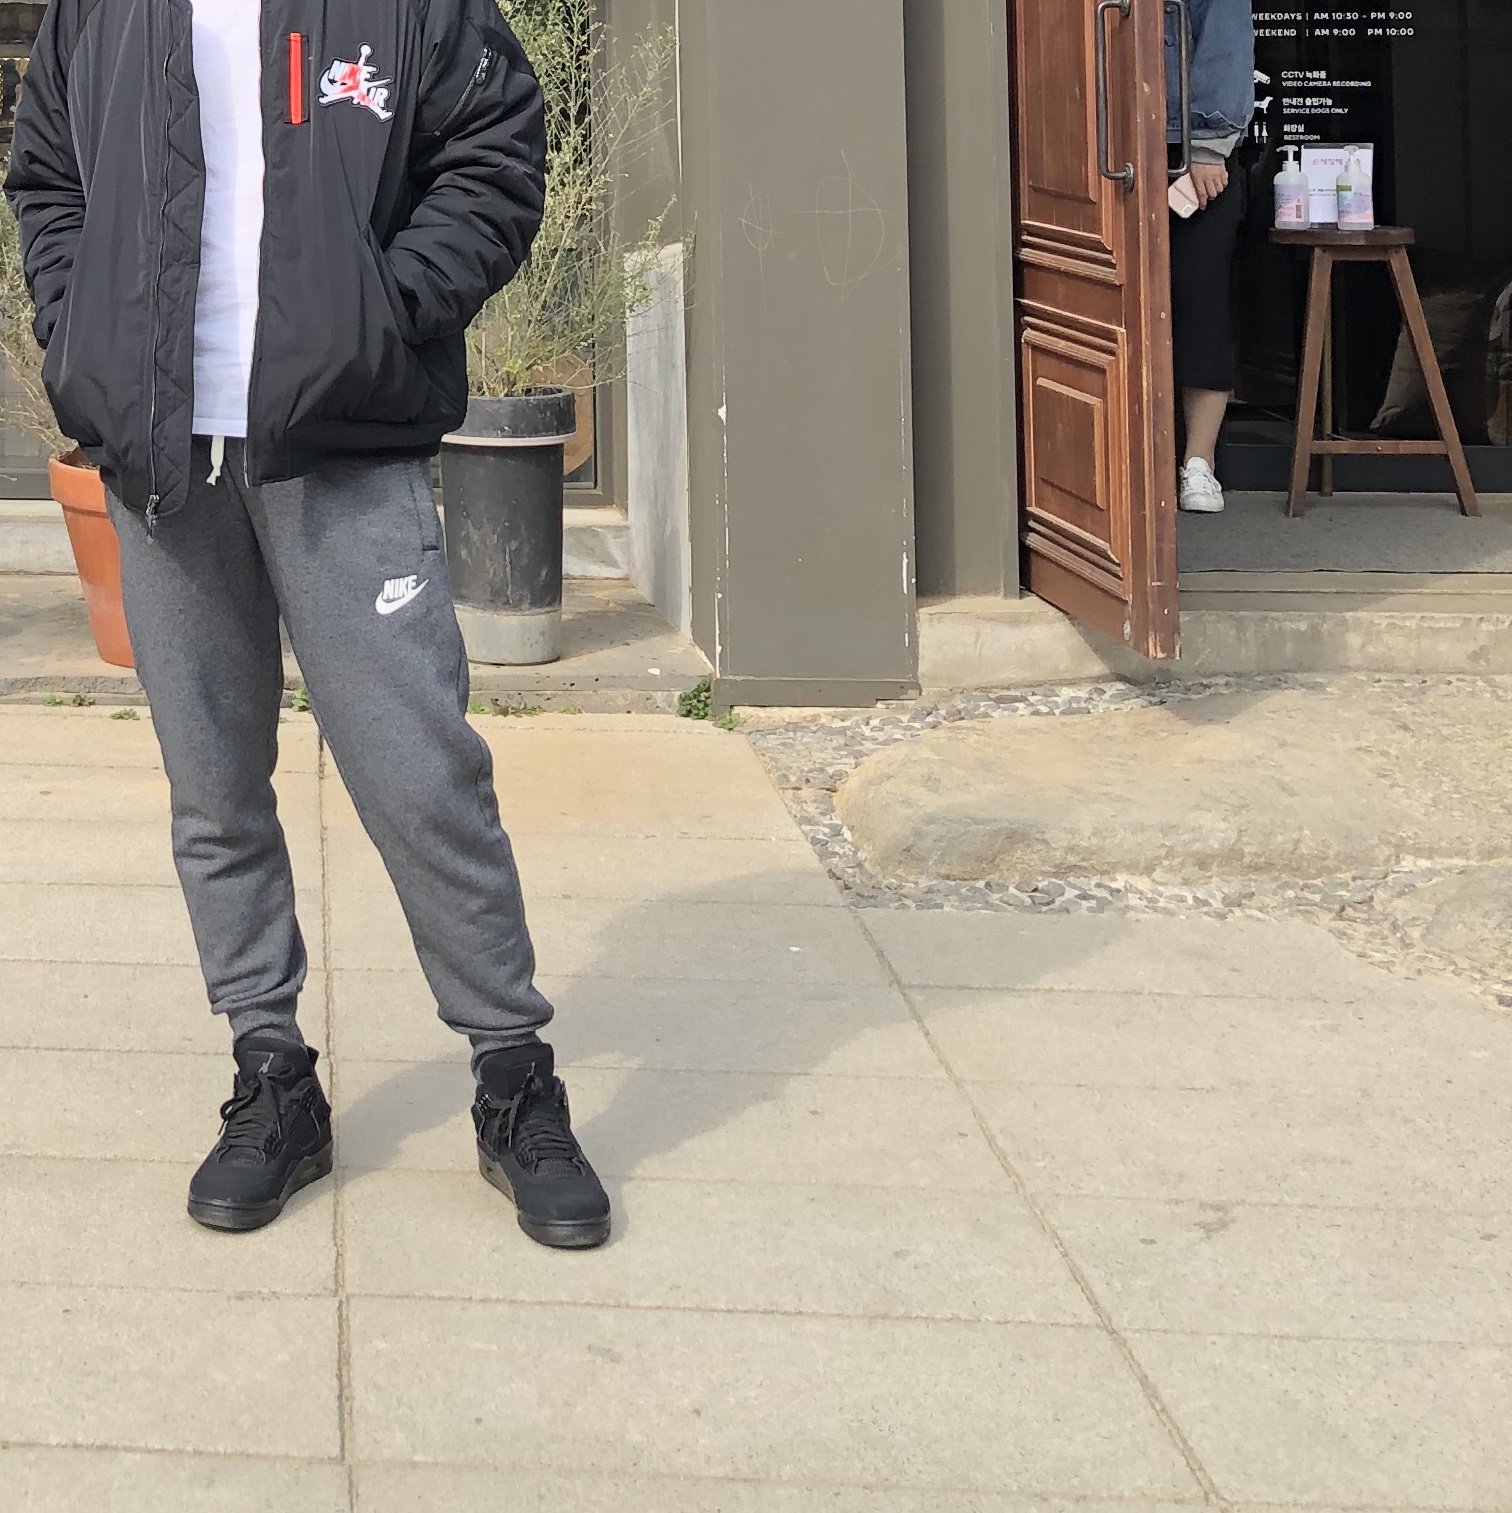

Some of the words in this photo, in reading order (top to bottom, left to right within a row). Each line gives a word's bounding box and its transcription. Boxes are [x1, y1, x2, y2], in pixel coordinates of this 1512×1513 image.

[1313, 11, 1330, 21] AM
[1331, 11, 1359, 21] 10:30
[1370, 11, 1386, 21] PM
[1388, 11, 1413, 21] 9:00
[1314, 27, 1330, 37] AM
[1332, 27, 1356, 37] 9:00
[1367, 27, 1383, 37] PM
[1385, 27, 1415, 37] 10:00
[1281, 70, 1305, 79] CCTV
[1281, 80, 1304, 88] VIDEO
[382, 574, 418, 600] NIKE
